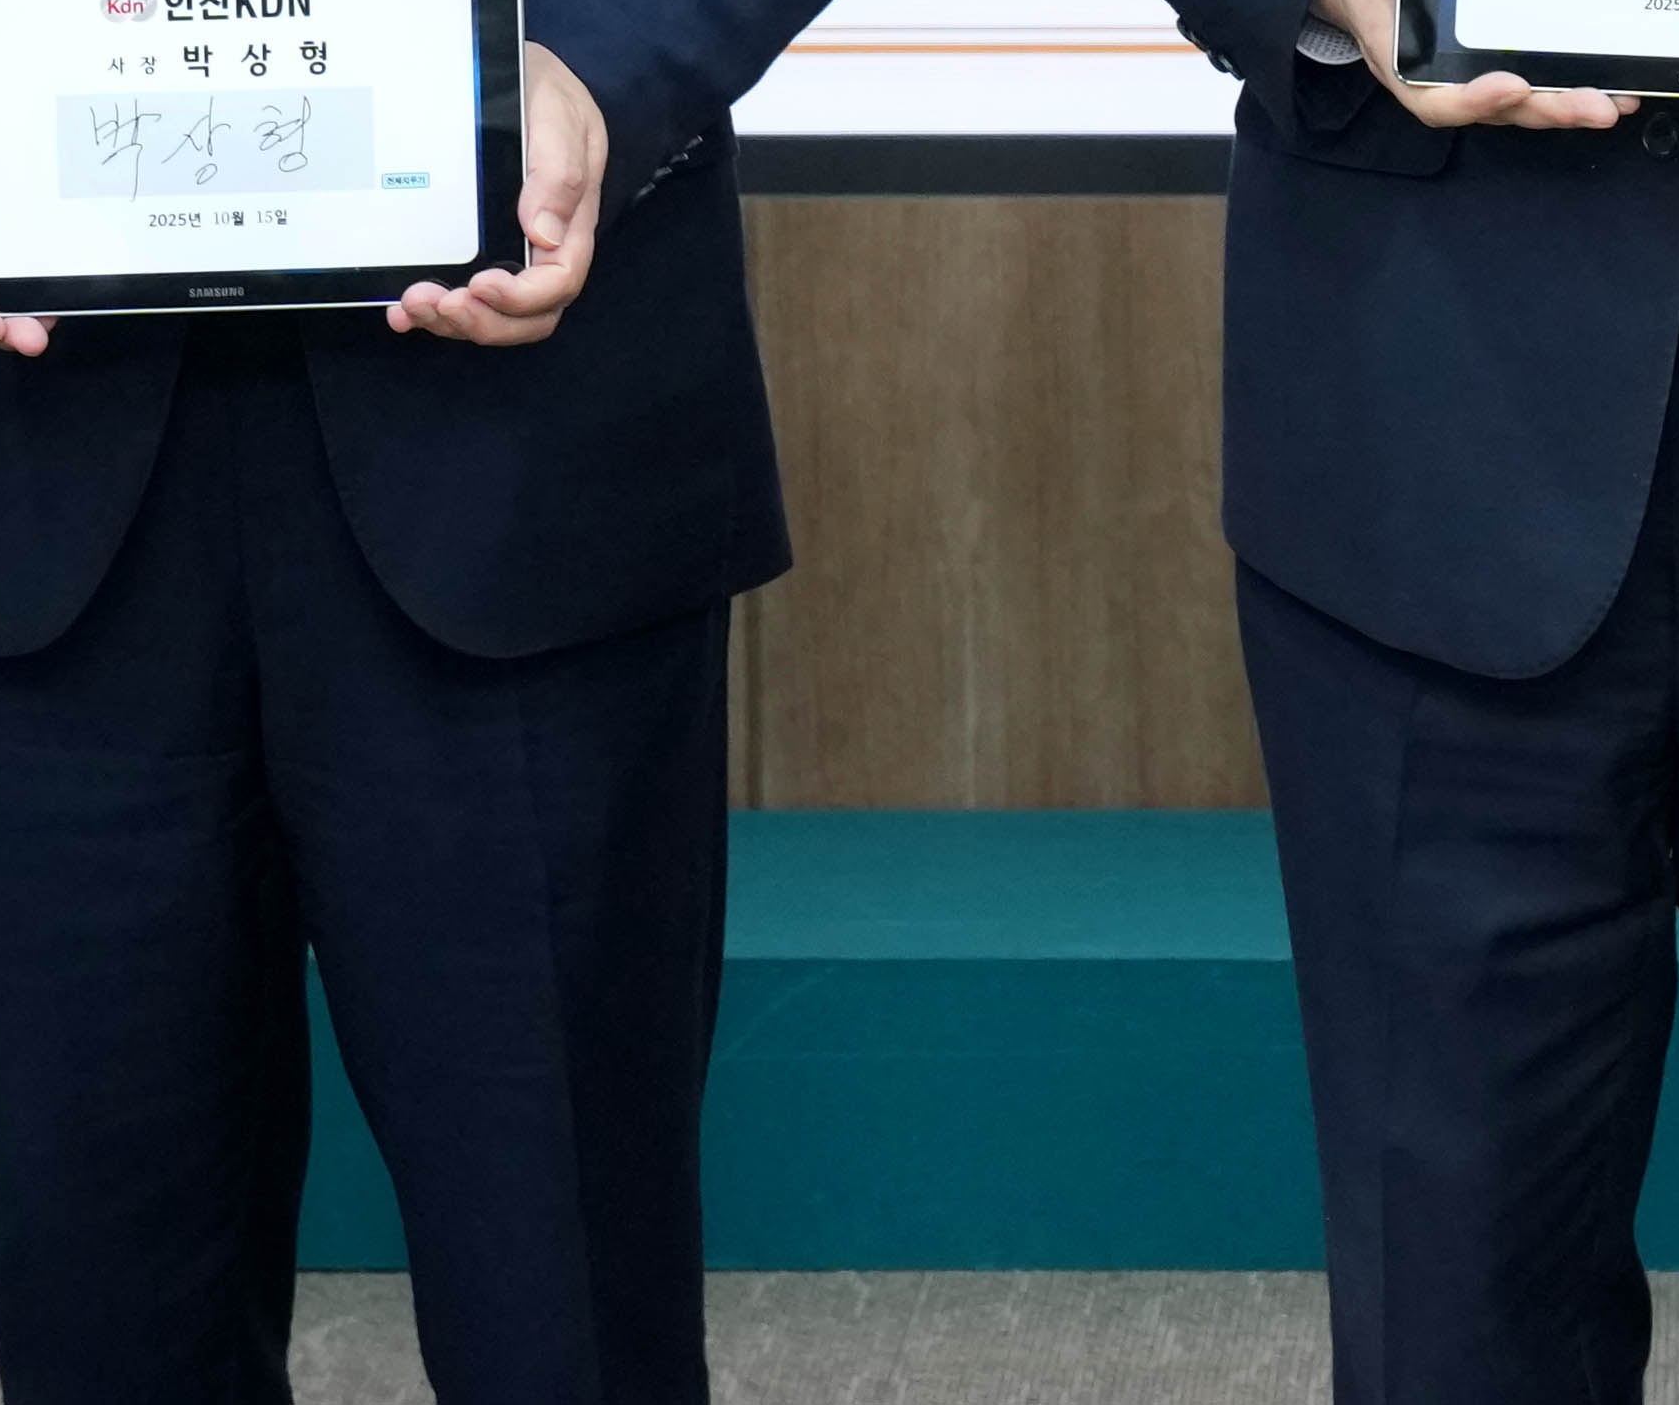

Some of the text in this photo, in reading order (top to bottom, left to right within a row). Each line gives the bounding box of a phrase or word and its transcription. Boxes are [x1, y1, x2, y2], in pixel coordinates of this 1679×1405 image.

[149, 208, 288, 229] 2025년 10월 15일
[189, 286, 245, 298] SAMSUNG
